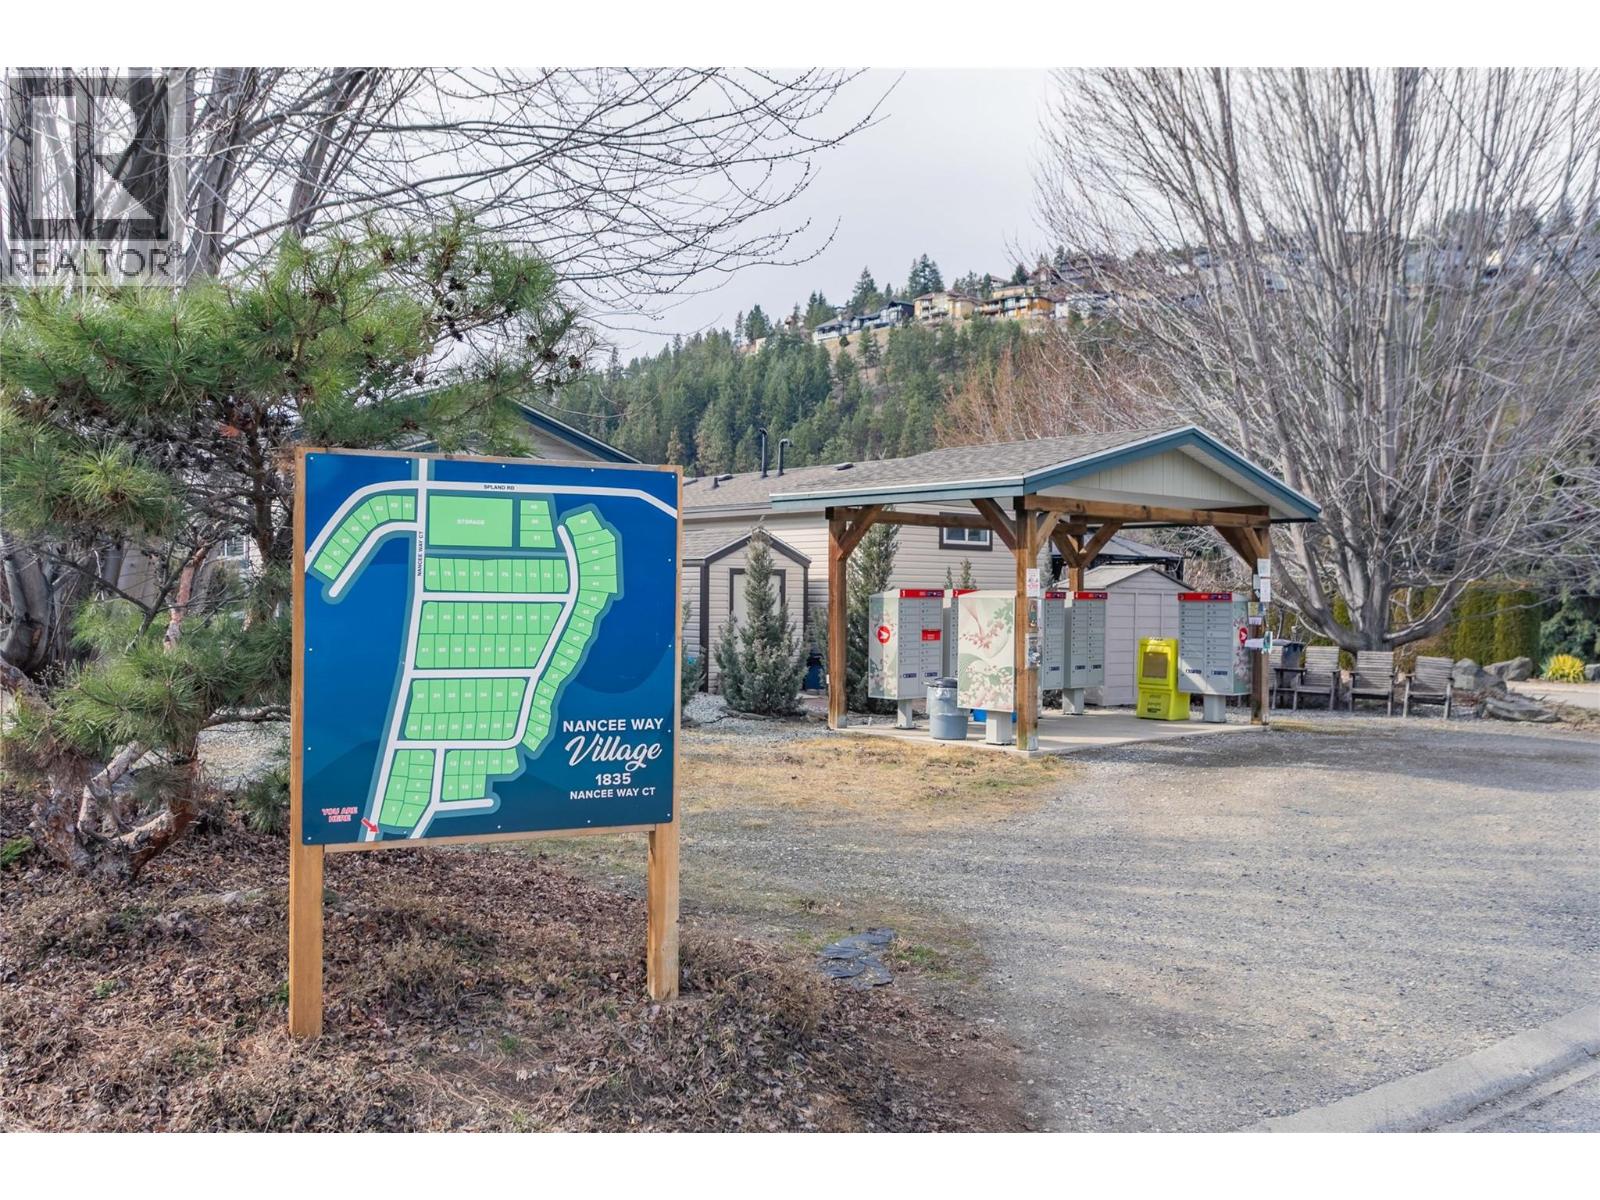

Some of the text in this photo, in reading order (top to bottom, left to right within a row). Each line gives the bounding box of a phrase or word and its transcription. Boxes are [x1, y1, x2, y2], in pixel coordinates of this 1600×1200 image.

[456, 518, 485, 526] STORAGE
[563, 718, 664, 733] NANCEE WAY
[564, 733, 662, 772] Village
[595, 772, 632, 786] 1835
[570, 787, 656, 800] NANCEE WAY CT
[321, 806, 358, 816] YOU ARE
[328, 815, 351, 823] HERE
